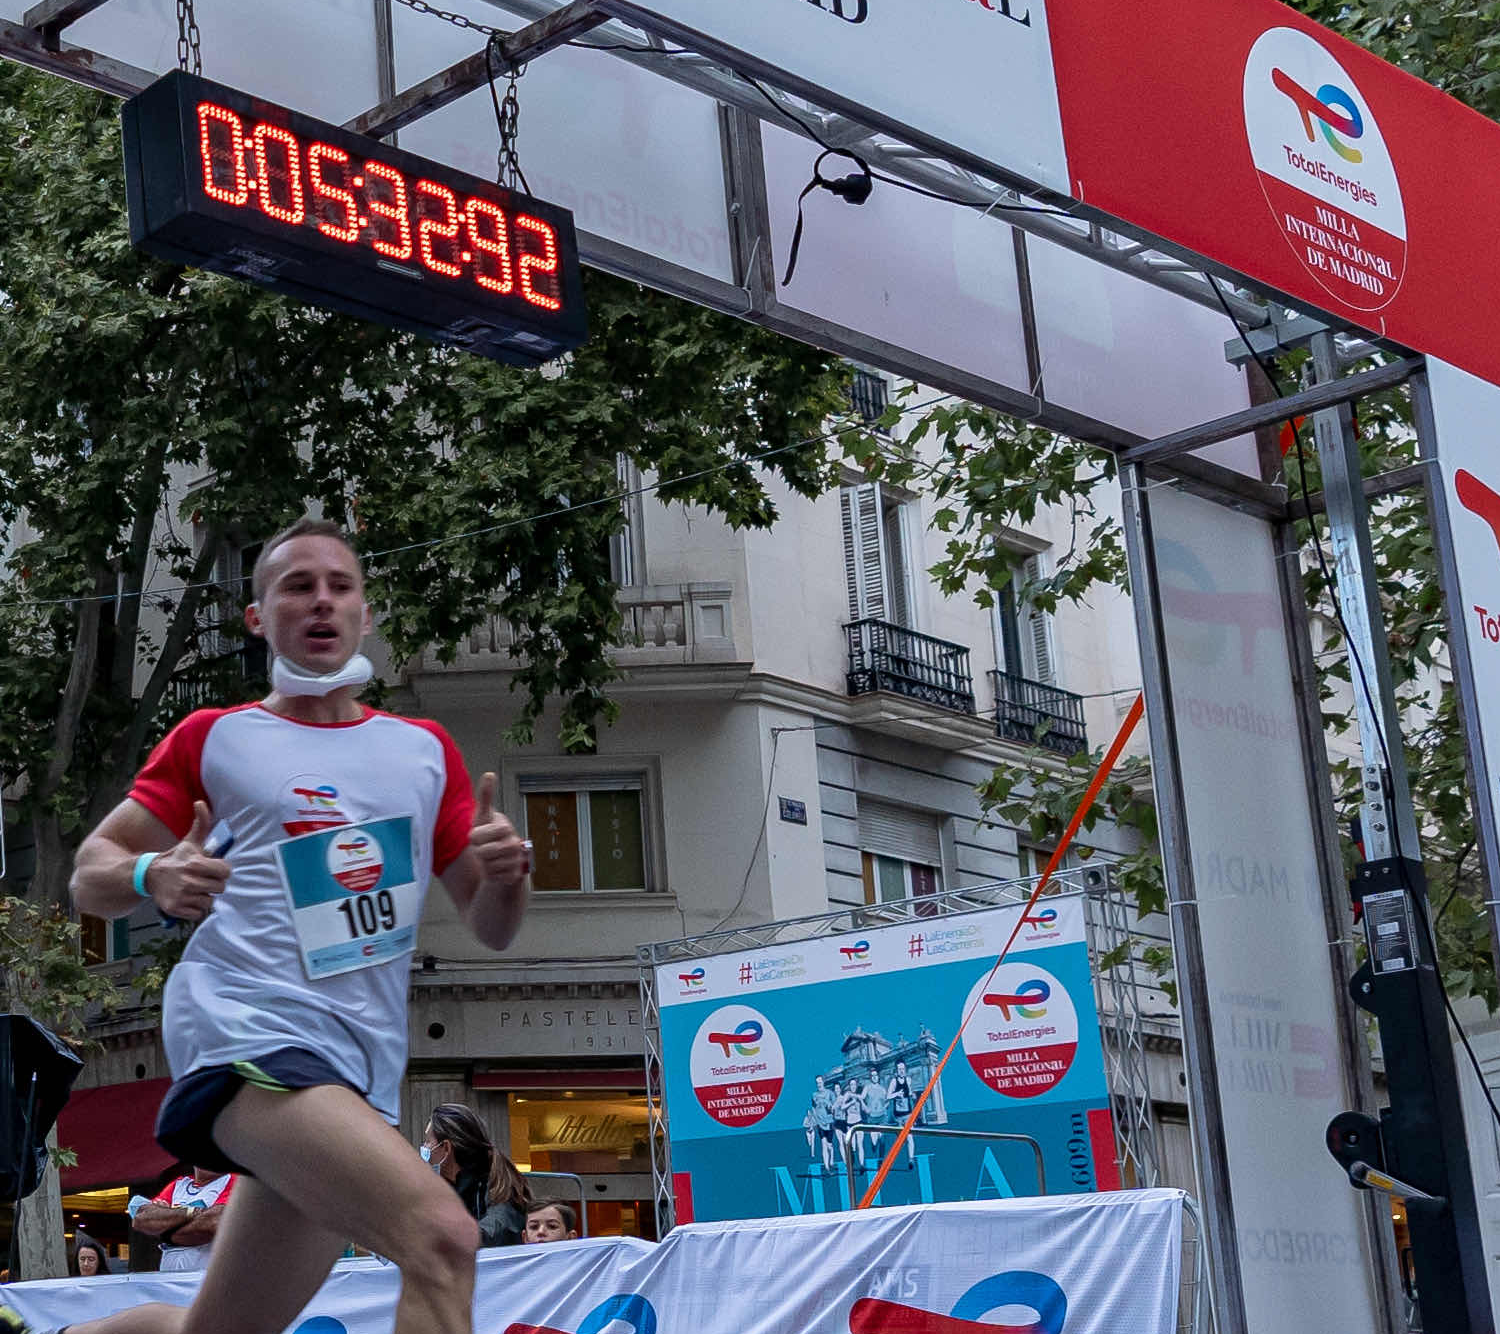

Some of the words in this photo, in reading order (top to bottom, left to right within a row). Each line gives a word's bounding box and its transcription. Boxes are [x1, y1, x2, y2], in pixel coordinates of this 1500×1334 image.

[1282, 144, 1378, 207] TotalEnergies
[1315, 205, 1361, 242] MILLA
[1306, 246, 1328, 271] DE
[1328, 255, 1384, 296] MADRID
[337, 889, 397, 939] 109
[986, 1025, 1057, 1043] TotalEnergies
[710, 1062, 768, 1077] TotalEnergies
[1006, 1051, 1040, 1063] MILLA
[1013, 1073, 1055, 1088] MADRID
